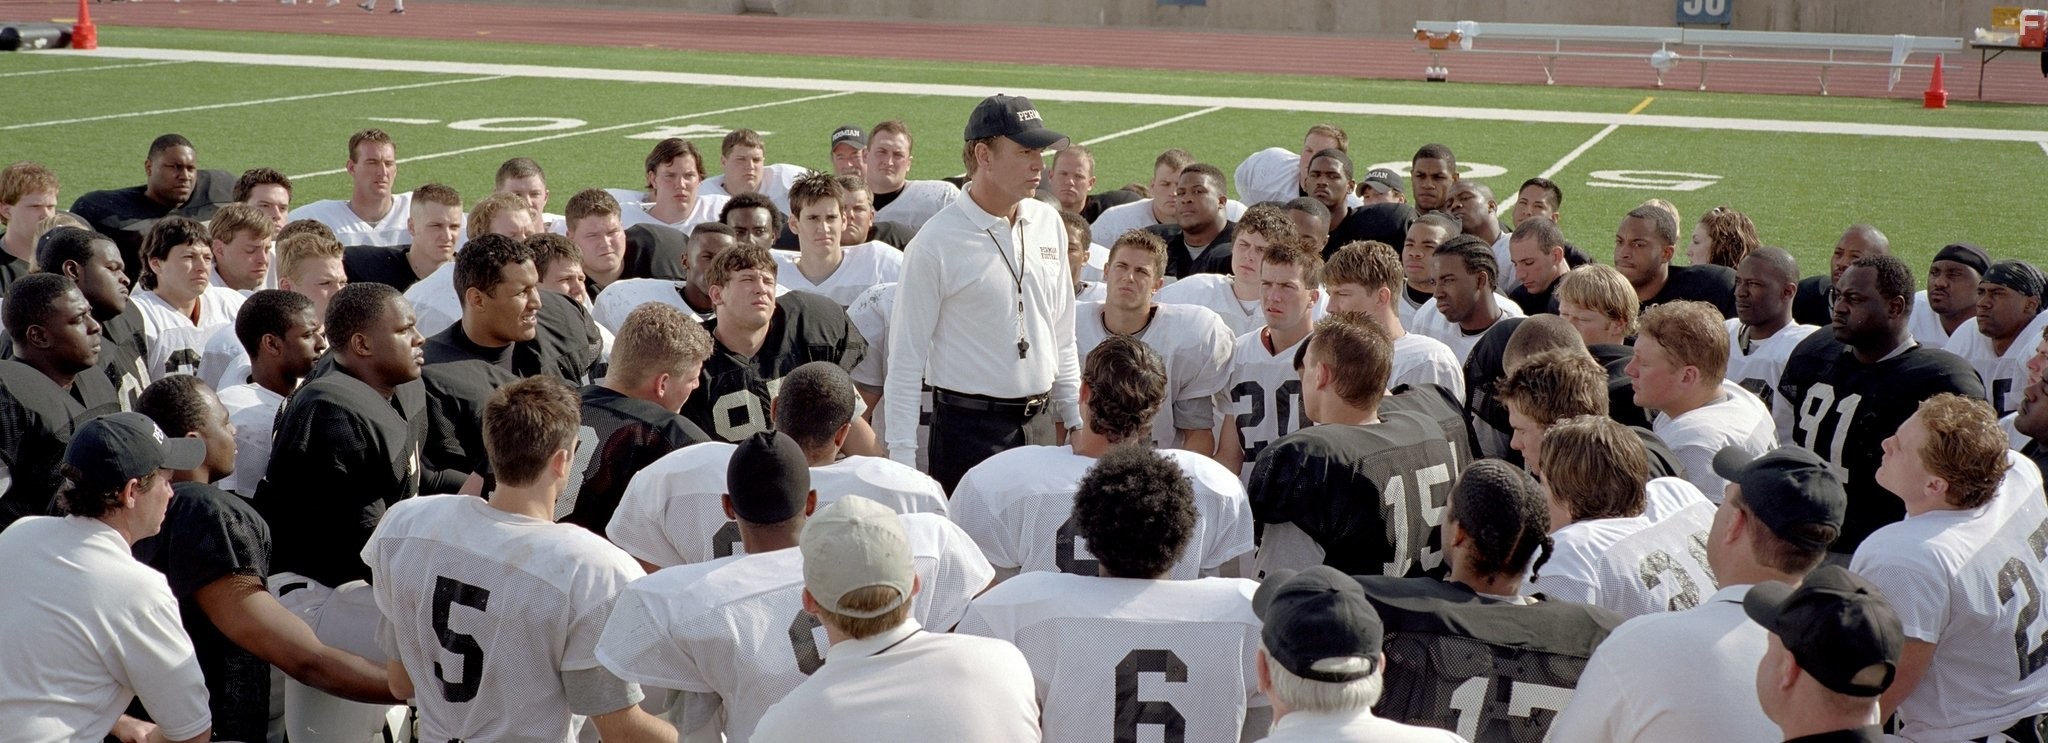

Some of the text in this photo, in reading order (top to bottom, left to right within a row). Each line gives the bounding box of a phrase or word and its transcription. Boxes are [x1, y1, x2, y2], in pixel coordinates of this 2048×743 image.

[833, 130, 860, 141] PERMIAN
[1017, 109, 1043, 121] PERM
[1384, 463, 1450, 578] 15
[432, 575, 490, 703] 5
[1113, 649, 1188, 743] 6
